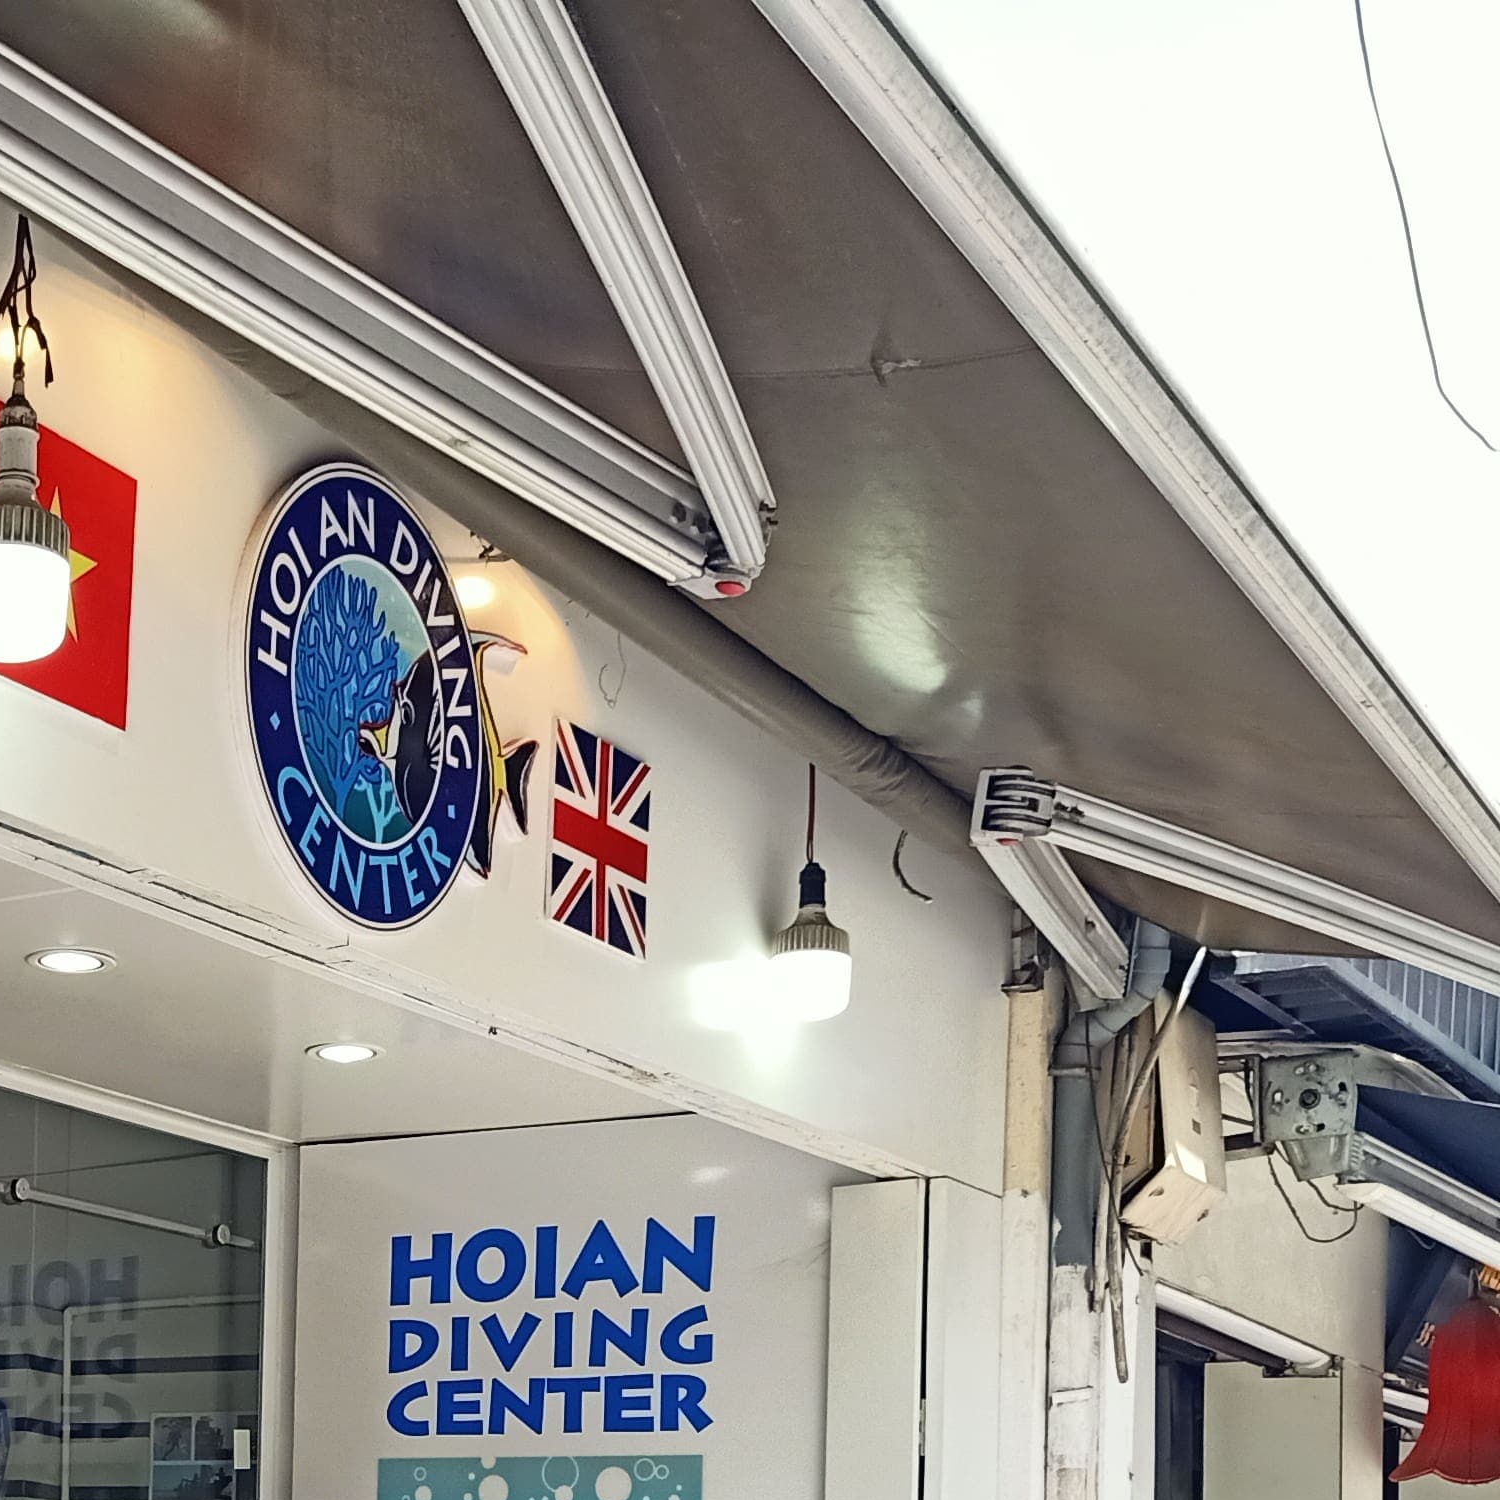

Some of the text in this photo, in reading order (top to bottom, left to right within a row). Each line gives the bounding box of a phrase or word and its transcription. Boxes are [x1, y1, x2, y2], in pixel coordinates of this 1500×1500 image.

[257, 489, 474, 771] HOI AN DIVING
[277, 766, 453, 915] CENTER
[389, 1215, 716, 1306] HOIAN
[388, 1304, 714, 1374] DIVING
[386, 1373, 714, 1437] CENTER
